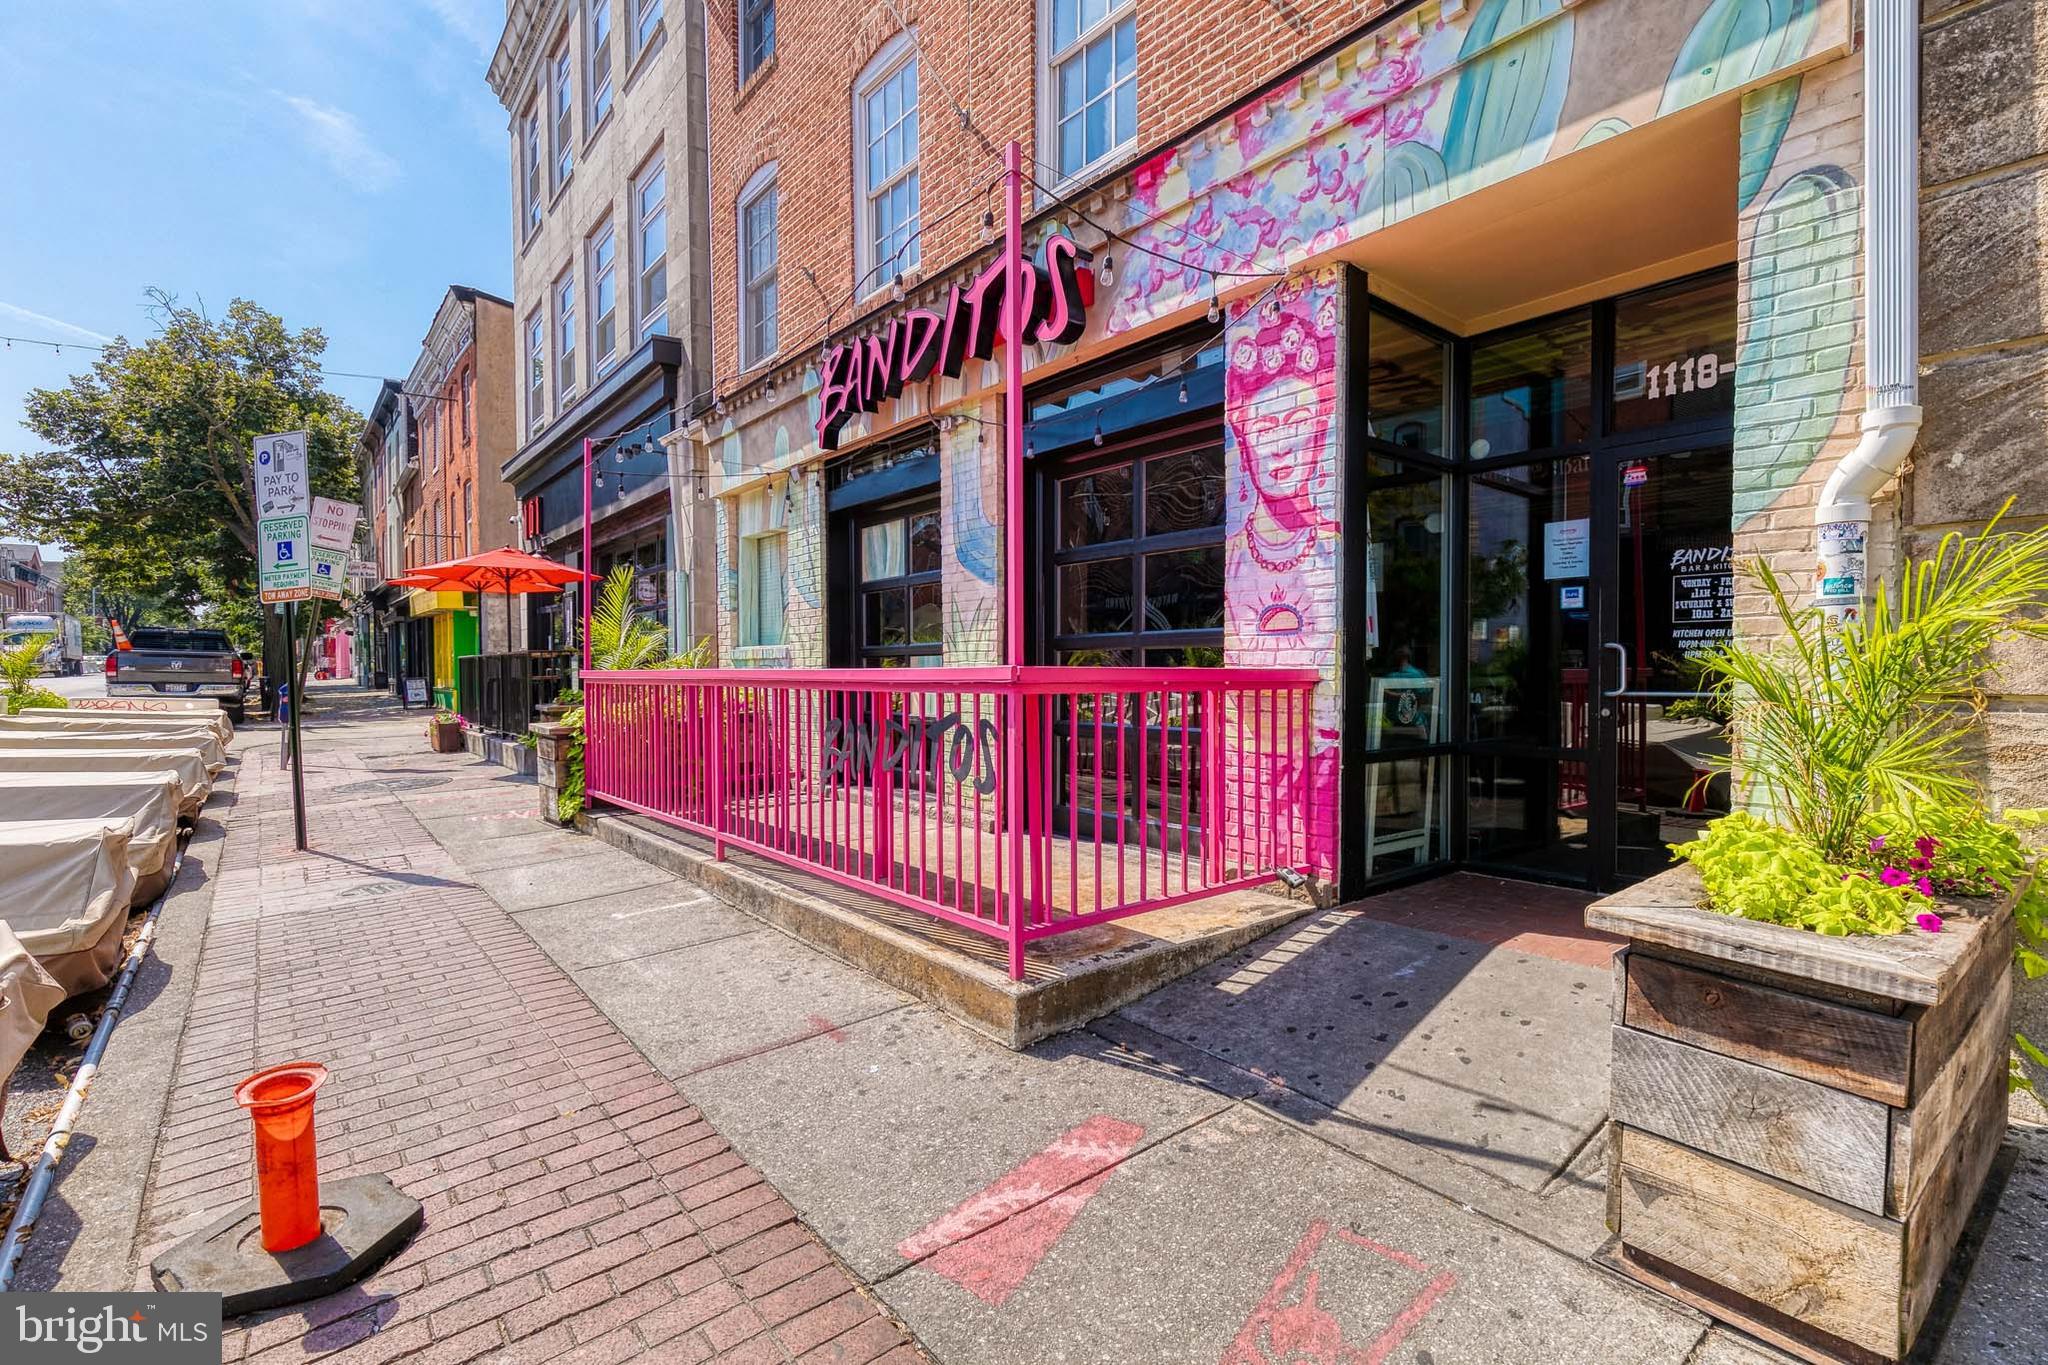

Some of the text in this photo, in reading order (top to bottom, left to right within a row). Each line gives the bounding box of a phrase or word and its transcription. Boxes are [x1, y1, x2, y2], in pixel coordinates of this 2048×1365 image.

[815, 233, 1086, 450] BANDITOS
[263, 472, 299, 486] PAY TO
[268, 484, 295, 497] PARK
[327, 504, 344, 516] NO
[264, 520, 303, 532] RESERVED
[312, 516, 352, 532] STOPPING
[267, 530, 301, 541] PARKING
[1681, 564, 1701, 572] BAR
[264, 571, 307, 582] METER PAYMENT
[273, 580, 300, 588] REQUIRED
[264, 588, 309, 600] TOW AWAY ZONE
[1691, 609, 1714, 619] 10AM
[1672, 629, 1703, 638] KITCHEN
[1705, 629, 1726, 637] OPEN
[820, 711, 1000, 795] BANDITOS
